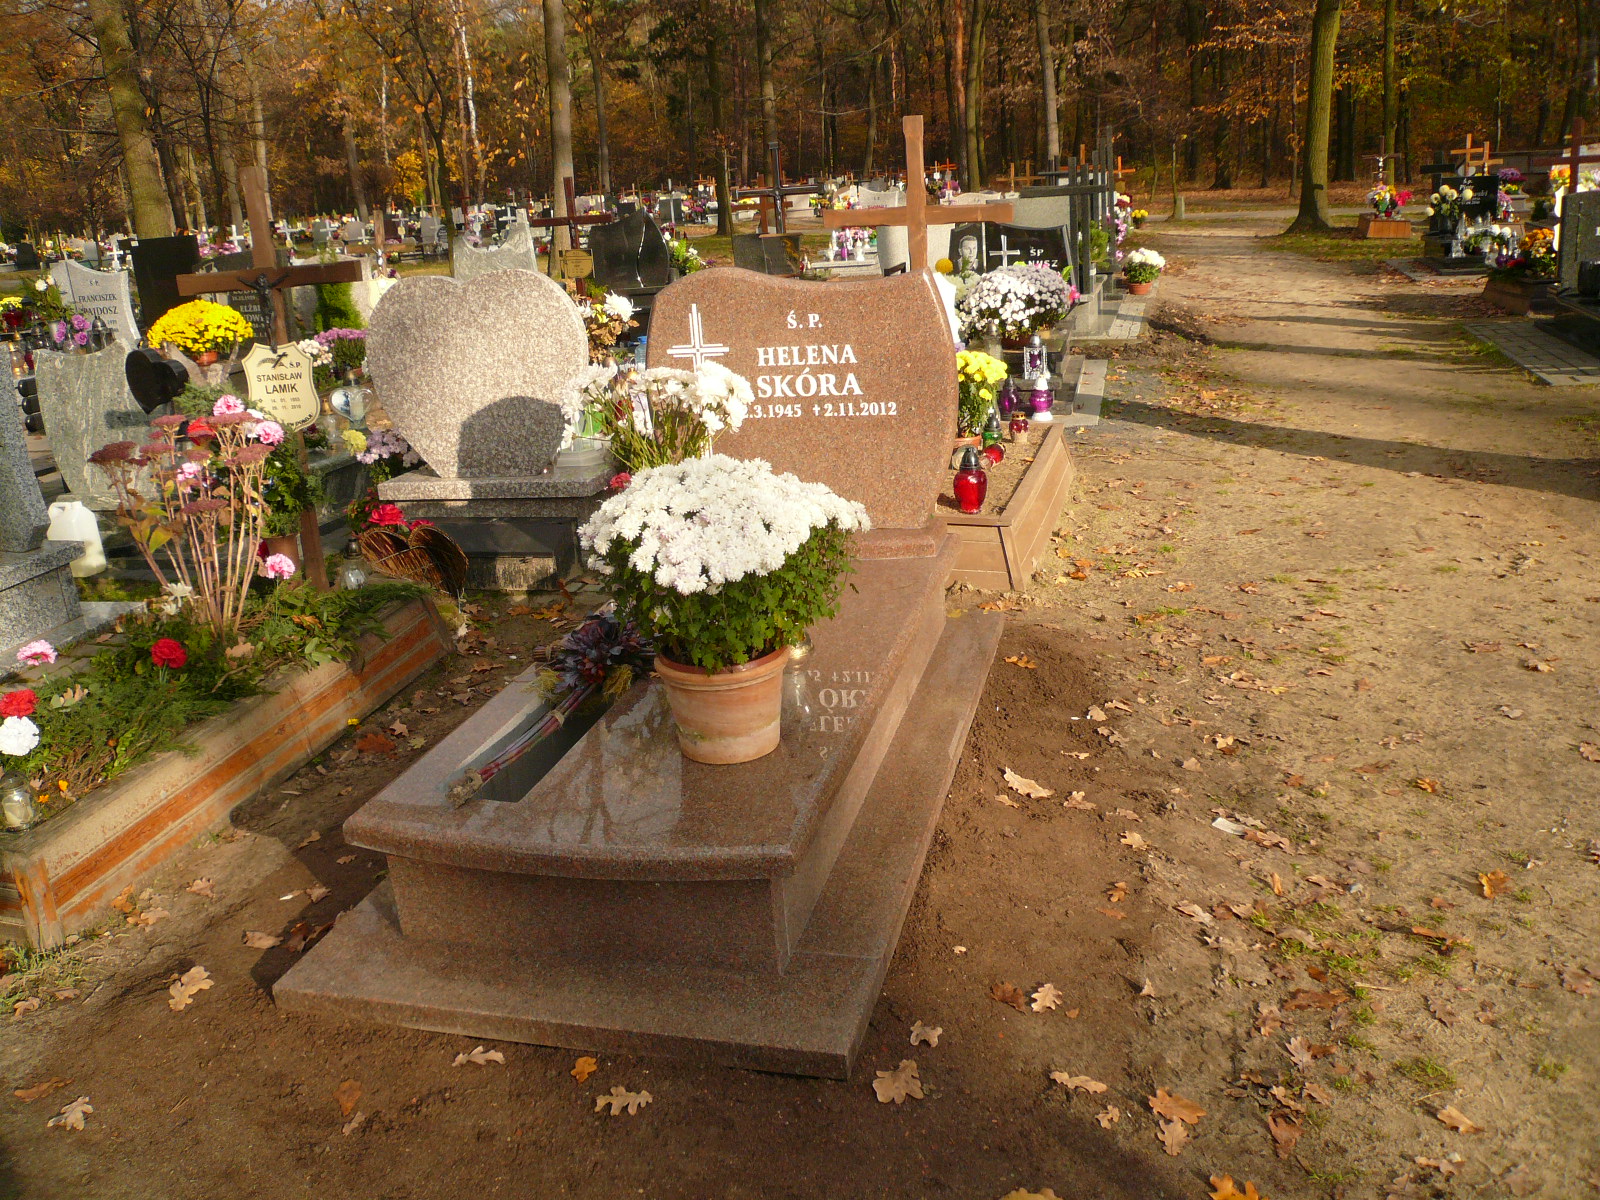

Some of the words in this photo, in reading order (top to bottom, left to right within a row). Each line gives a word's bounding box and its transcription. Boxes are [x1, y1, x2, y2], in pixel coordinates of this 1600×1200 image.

[757, 344, 857, 367] HELENA
[256, 372, 302, 382] STANISŁAW
[757, 368, 863, 398] SKÓRA
[265, 383, 298, 394] LAMIK
